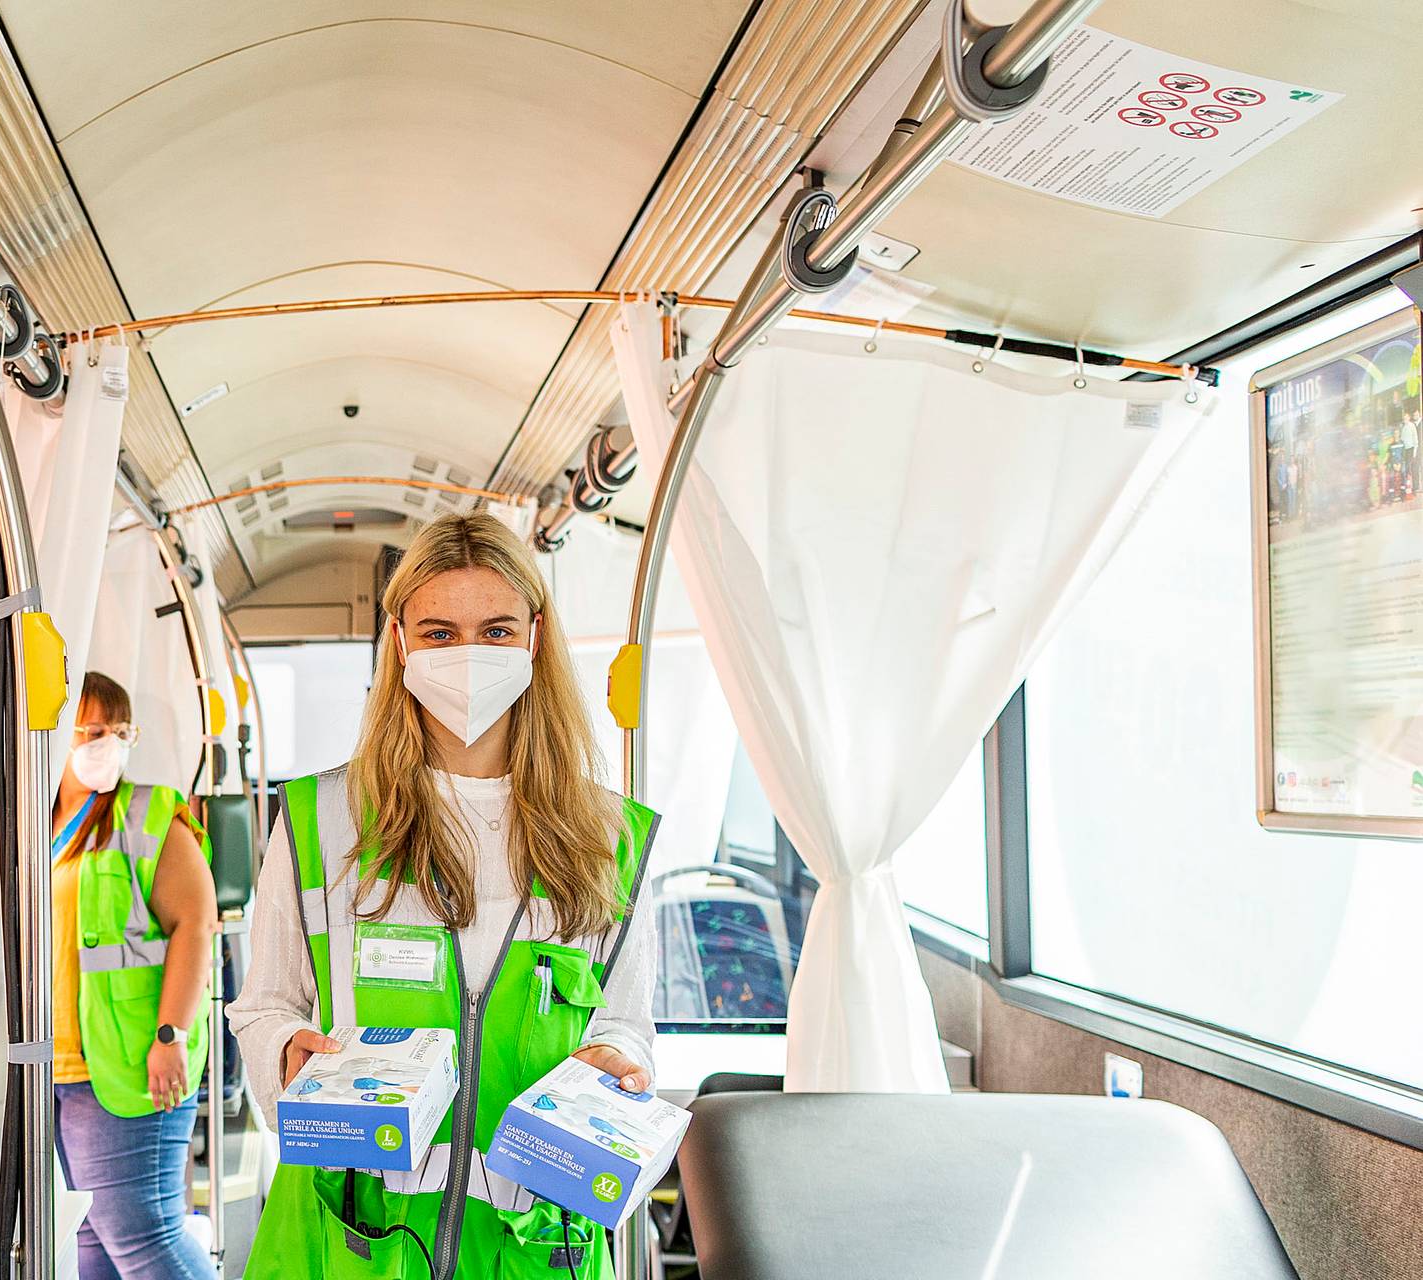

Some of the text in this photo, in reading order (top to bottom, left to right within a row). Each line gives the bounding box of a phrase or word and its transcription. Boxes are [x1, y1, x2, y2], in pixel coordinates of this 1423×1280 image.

[1269, 381, 1293, 417] mit
[1297, 375, 1321, 405] uns
[306, 1120, 339, 1128] D'EXAMEN
[315, 1126, 338, 1134] USAGE
[338, 1127, 365, 1135] UNIQUE
[384, 1130, 394, 1142] L
[505, 1124, 574, 1161] GANTS D'EXAMEN EN
[503, 1130, 530, 1146] NITRILE
[535, 1144, 559, 1161] USAGE
[558, 1156, 586, 1174] UNIQUE
[594, 1176, 618, 1195] XL
